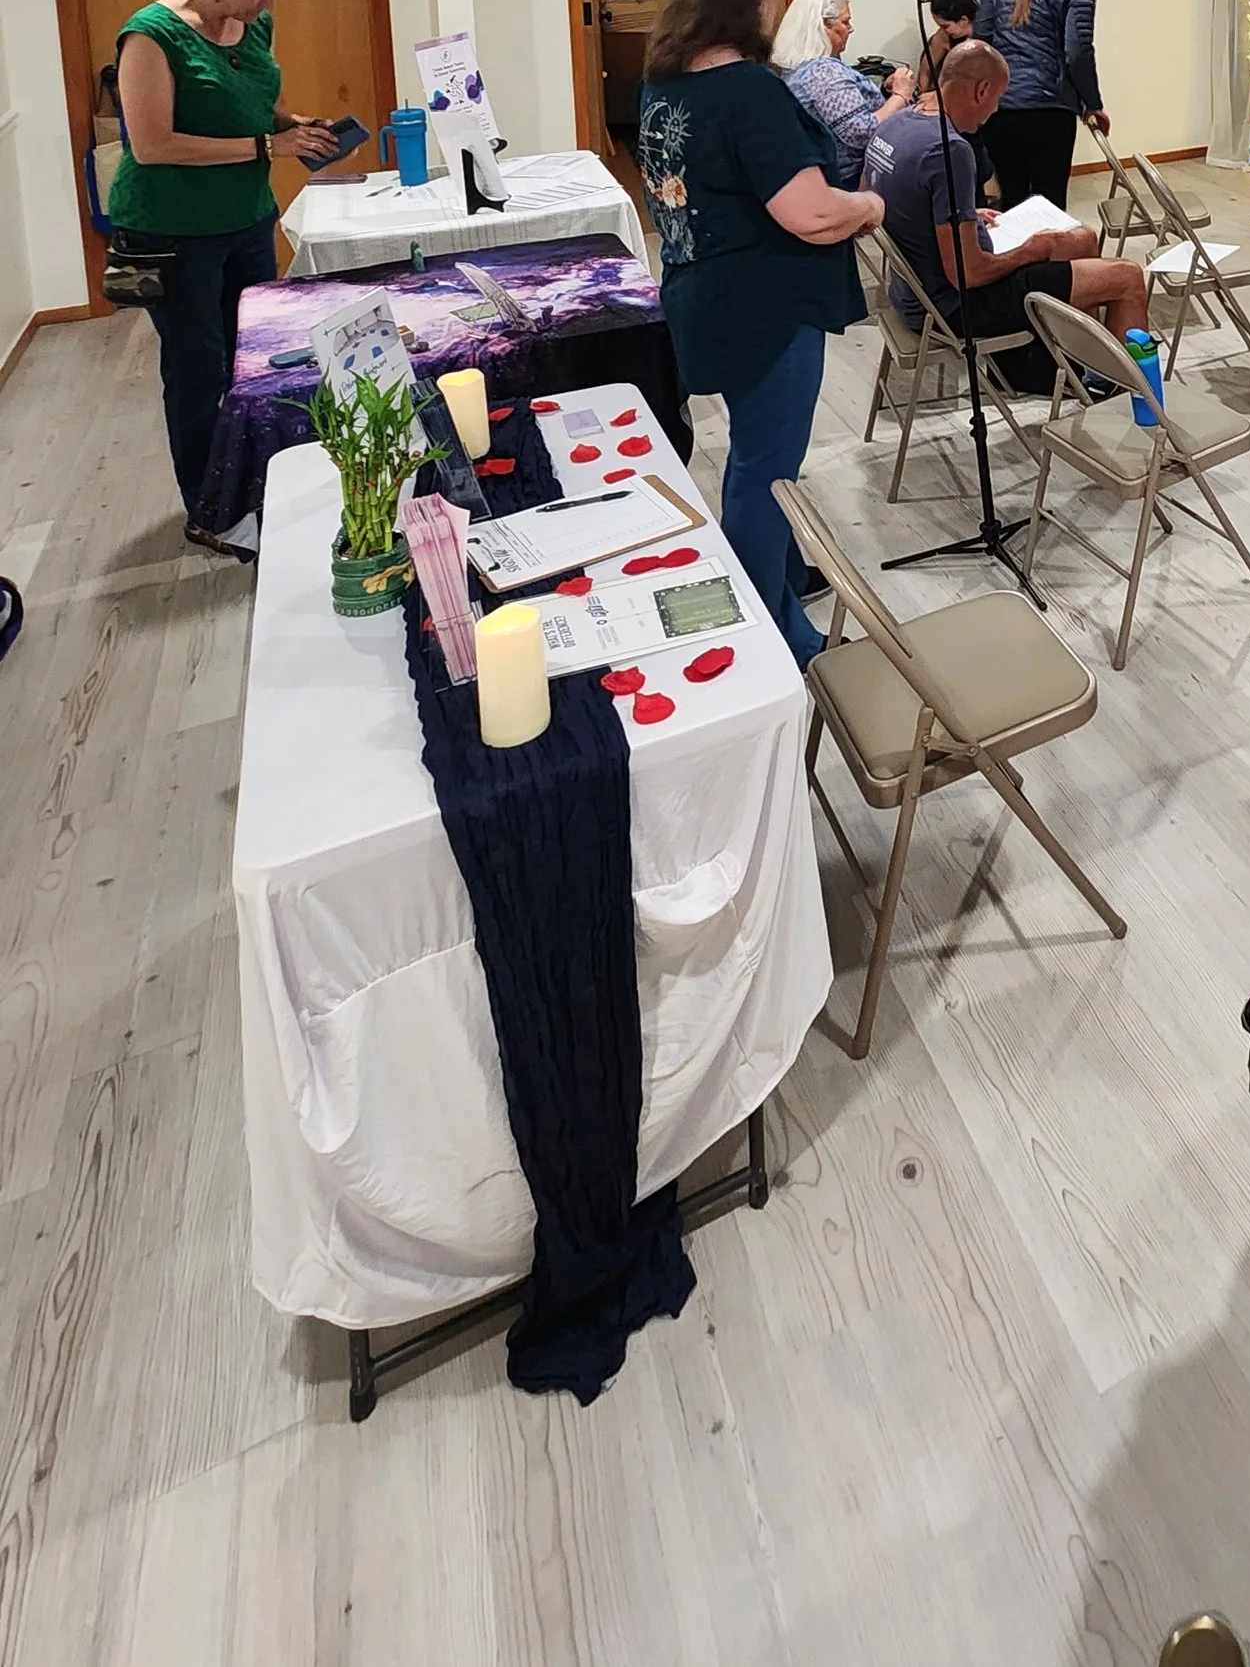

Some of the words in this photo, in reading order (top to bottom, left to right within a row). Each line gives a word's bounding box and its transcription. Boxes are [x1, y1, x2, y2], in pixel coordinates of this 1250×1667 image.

[872, 135, 895, 157] DENVER
[498, 557, 521, 573] SIGN
[542, 619, 554, 631] THE
[553, 615, 576, 649] DIFFERENCE?
[544, 630, 561, 650] WHAT'S
